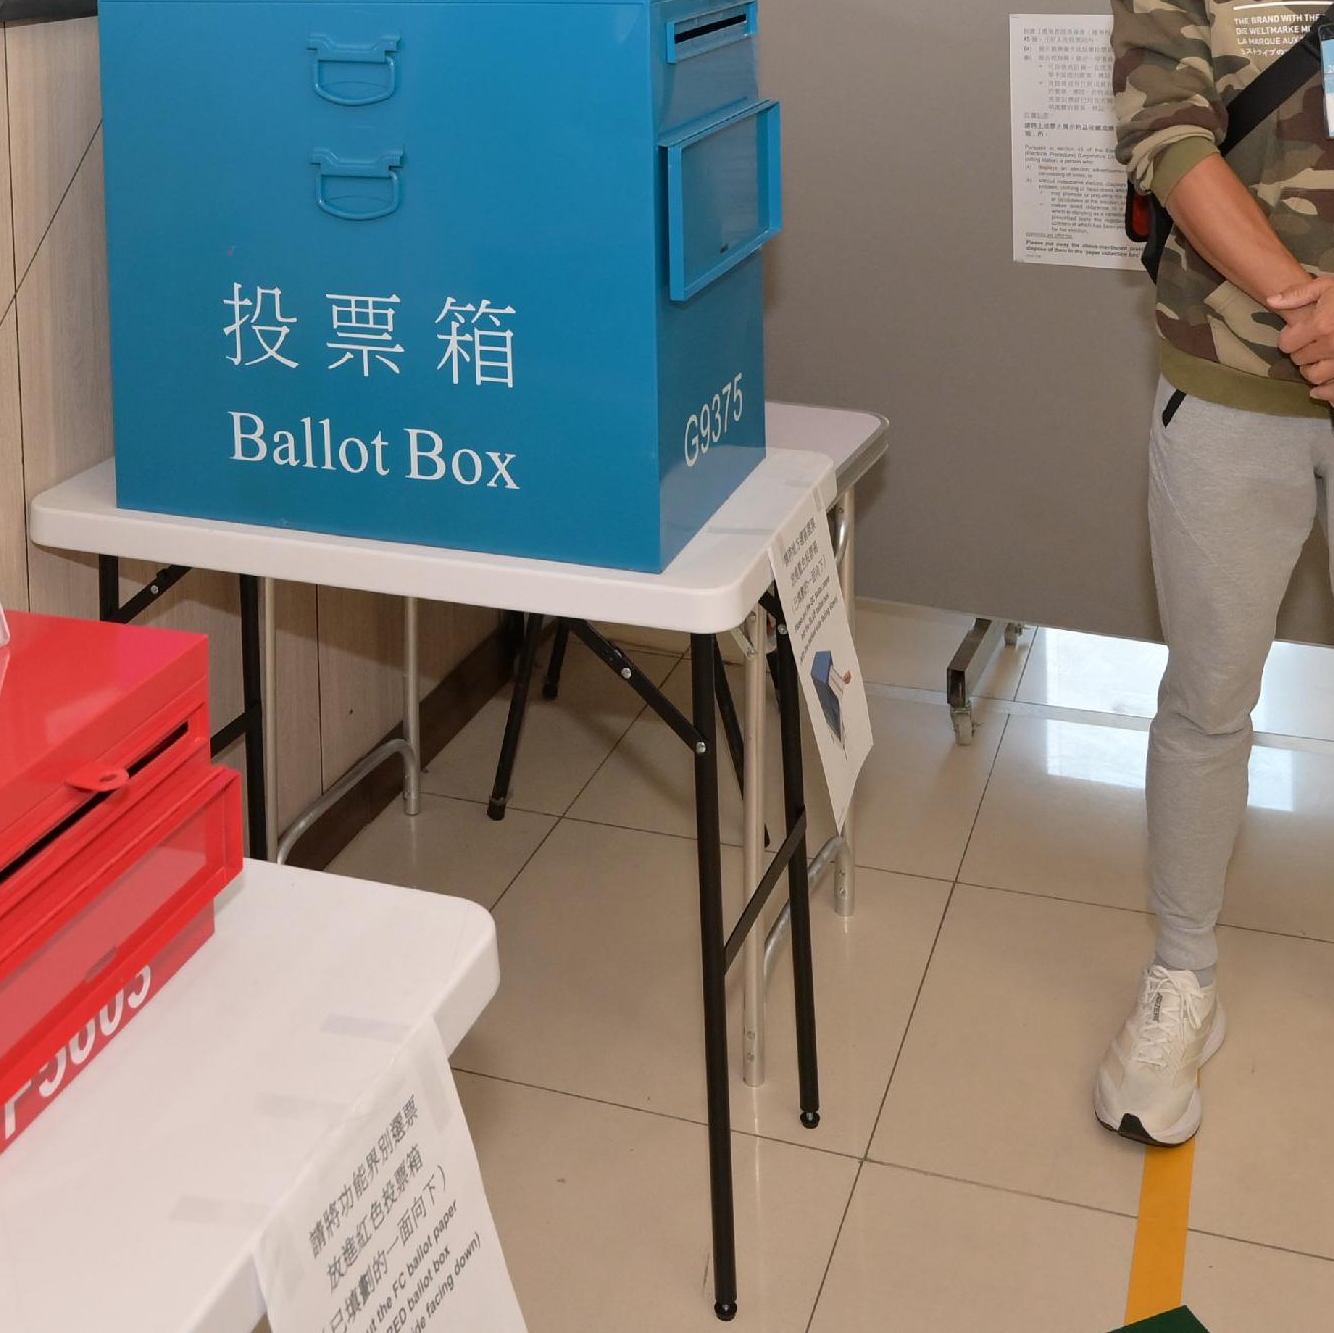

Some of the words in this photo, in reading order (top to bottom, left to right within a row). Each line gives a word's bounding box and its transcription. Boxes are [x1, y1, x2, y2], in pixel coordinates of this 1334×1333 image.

[1248, 37, 1281, 45] MARQUE
[1249, 26, 1299, 34] WELTMARKE
[1251, 16, 1279, 24] BRAND
[223, 281, 517, 388] 投票箱
[227, 411, 390, 477] Ballot
[403, 428, 521, 490] Box
[683, 373, 744, 468] G9375
[308, 1094, 418, 1259] 請將功能界別選票
[326, 1144, 424, 1294] 放進紅色投票箱
[377, 1296, 393, 1323] the
[392, 1271, 407, 1299] FC
[407, 1234, 434, 1277] ballot
[432, 1199, 458, 1244] paper
[407, 1267, 435, 1312] ballot
[432, 1244, 451, 1275] box
[425, 1273, 455, 1320] facing
[454, 1231, 482, 1278] down)
